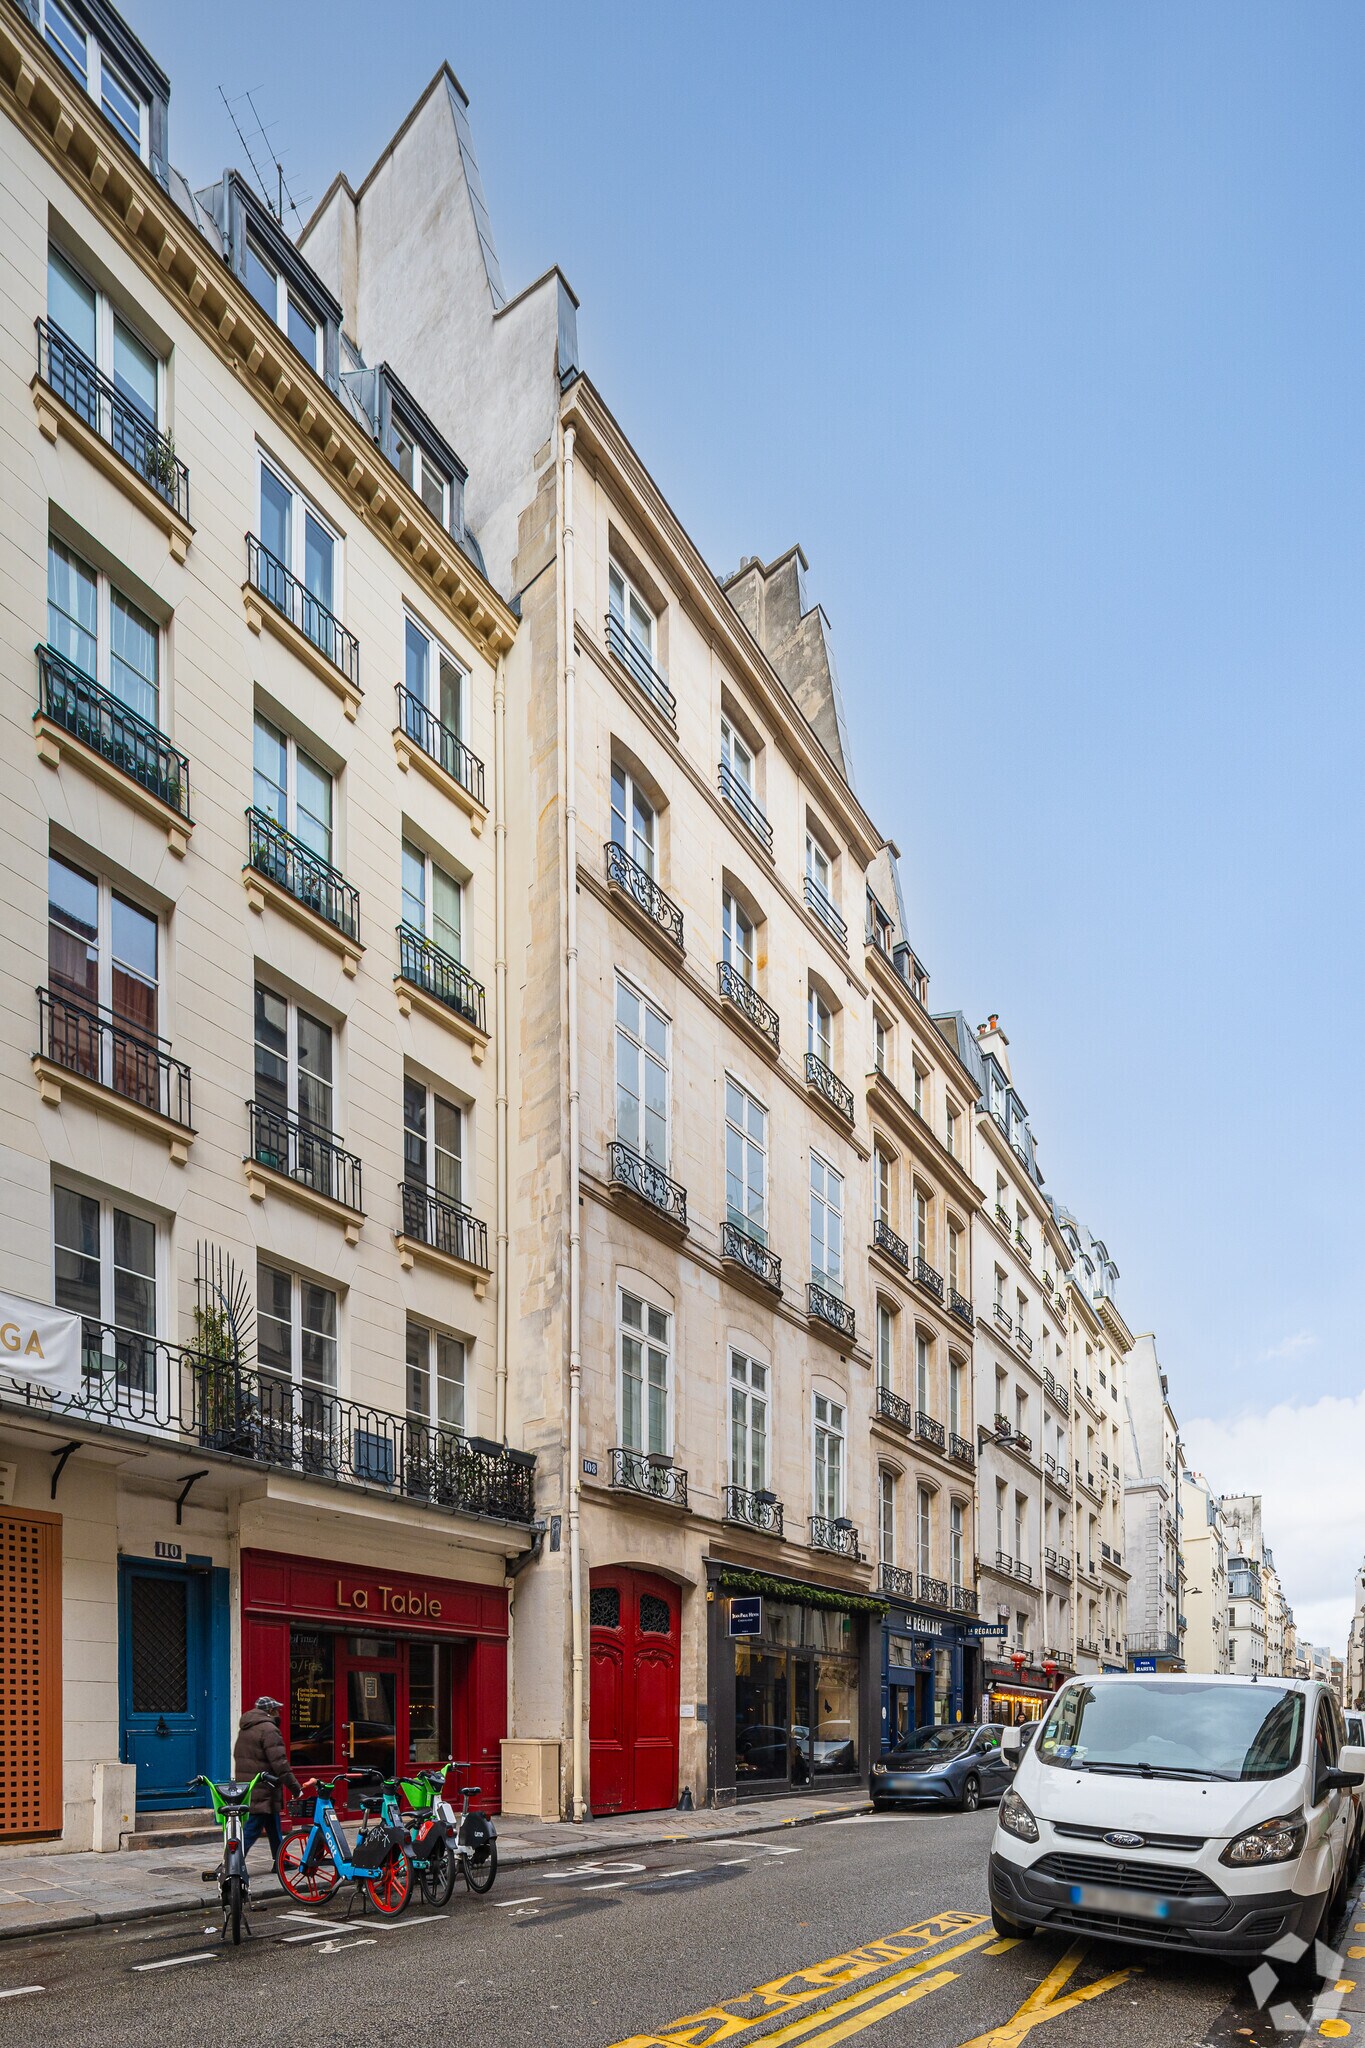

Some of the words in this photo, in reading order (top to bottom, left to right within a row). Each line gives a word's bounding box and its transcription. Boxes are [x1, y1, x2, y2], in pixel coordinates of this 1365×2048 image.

[0, 1323, 45, 1359] GA
[158, 1543, 179, 1557] 110
[338, 1580, 368, 1609] La
[378, 1586, 442, 1617] Table
[913, 1615, 943, 1636] RÉGALADE
[974, 1627, 1004, 1635] RÉGALADE
